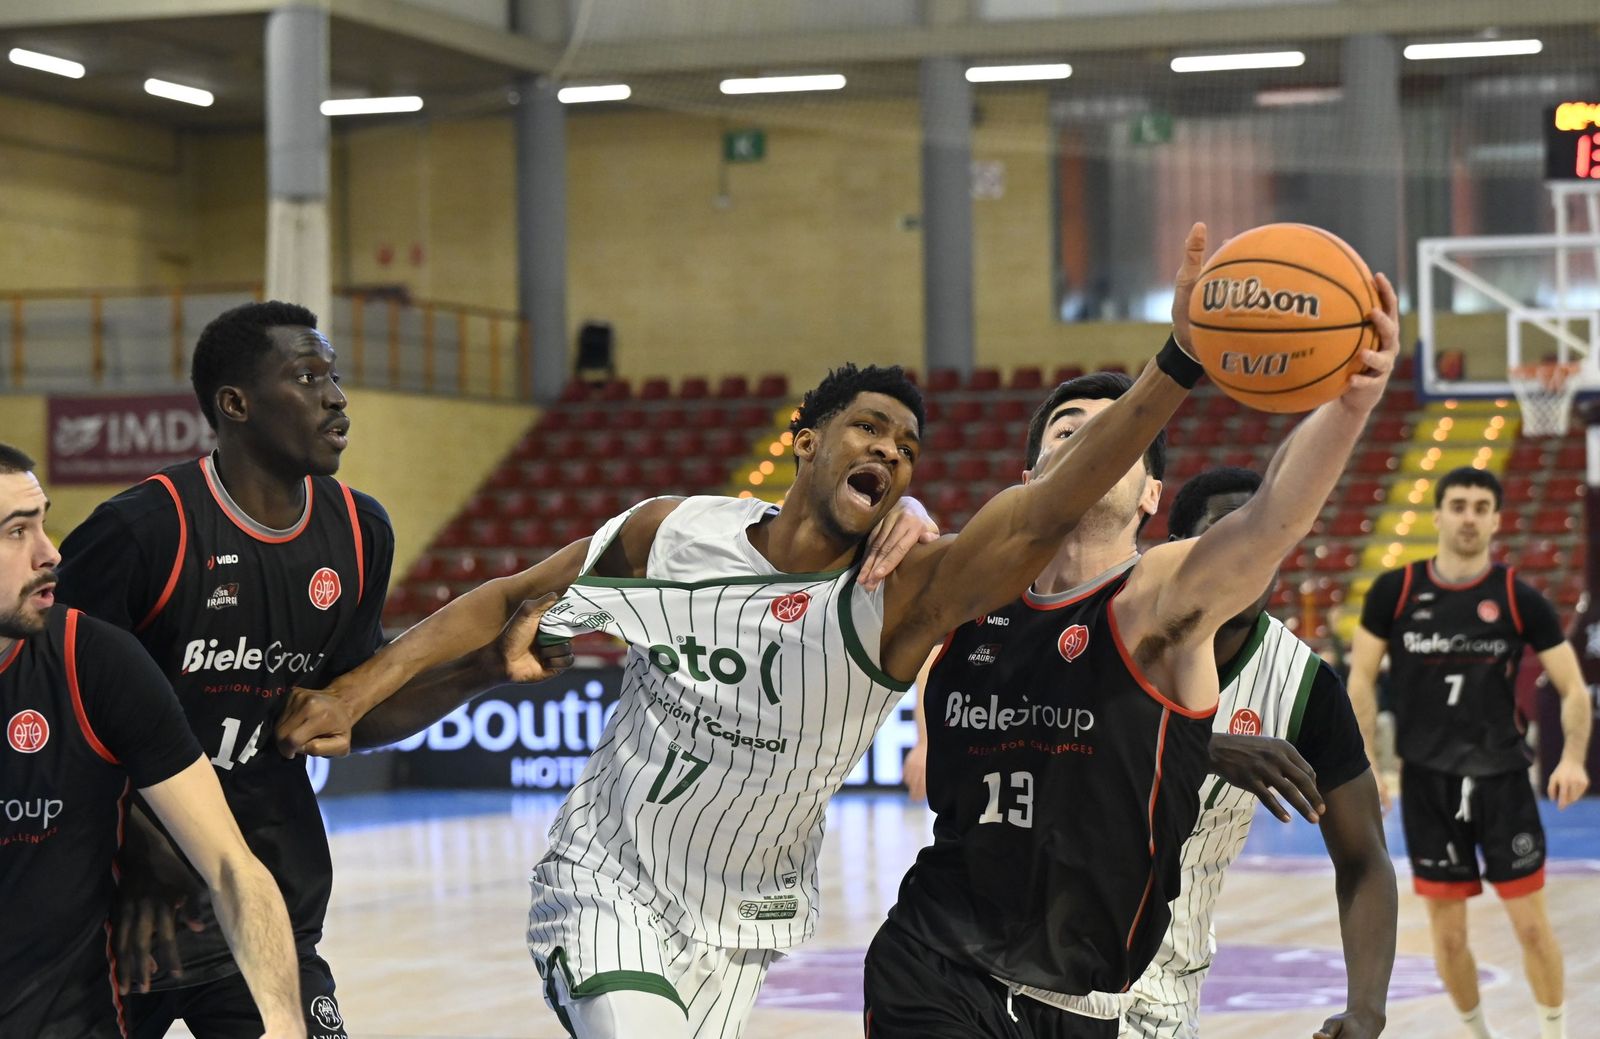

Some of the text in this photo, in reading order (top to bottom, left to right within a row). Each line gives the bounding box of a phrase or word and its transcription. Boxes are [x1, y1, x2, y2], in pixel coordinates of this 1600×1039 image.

[1202, 276, 1319, 318] Wilson
[1221, 351, 1290, 376] EVO
[987, 615, 1010, 626] WIBO
[1402, 631, 1508, 656] BieleGroup
[1444, 674, 1464, 706] 7
[706, 720, 788, 754] Cajasol
[1001, 739, 1025, 752] FOR
[645, 749, 710, 805] 17
[978, 771, 1034, 829] 13
